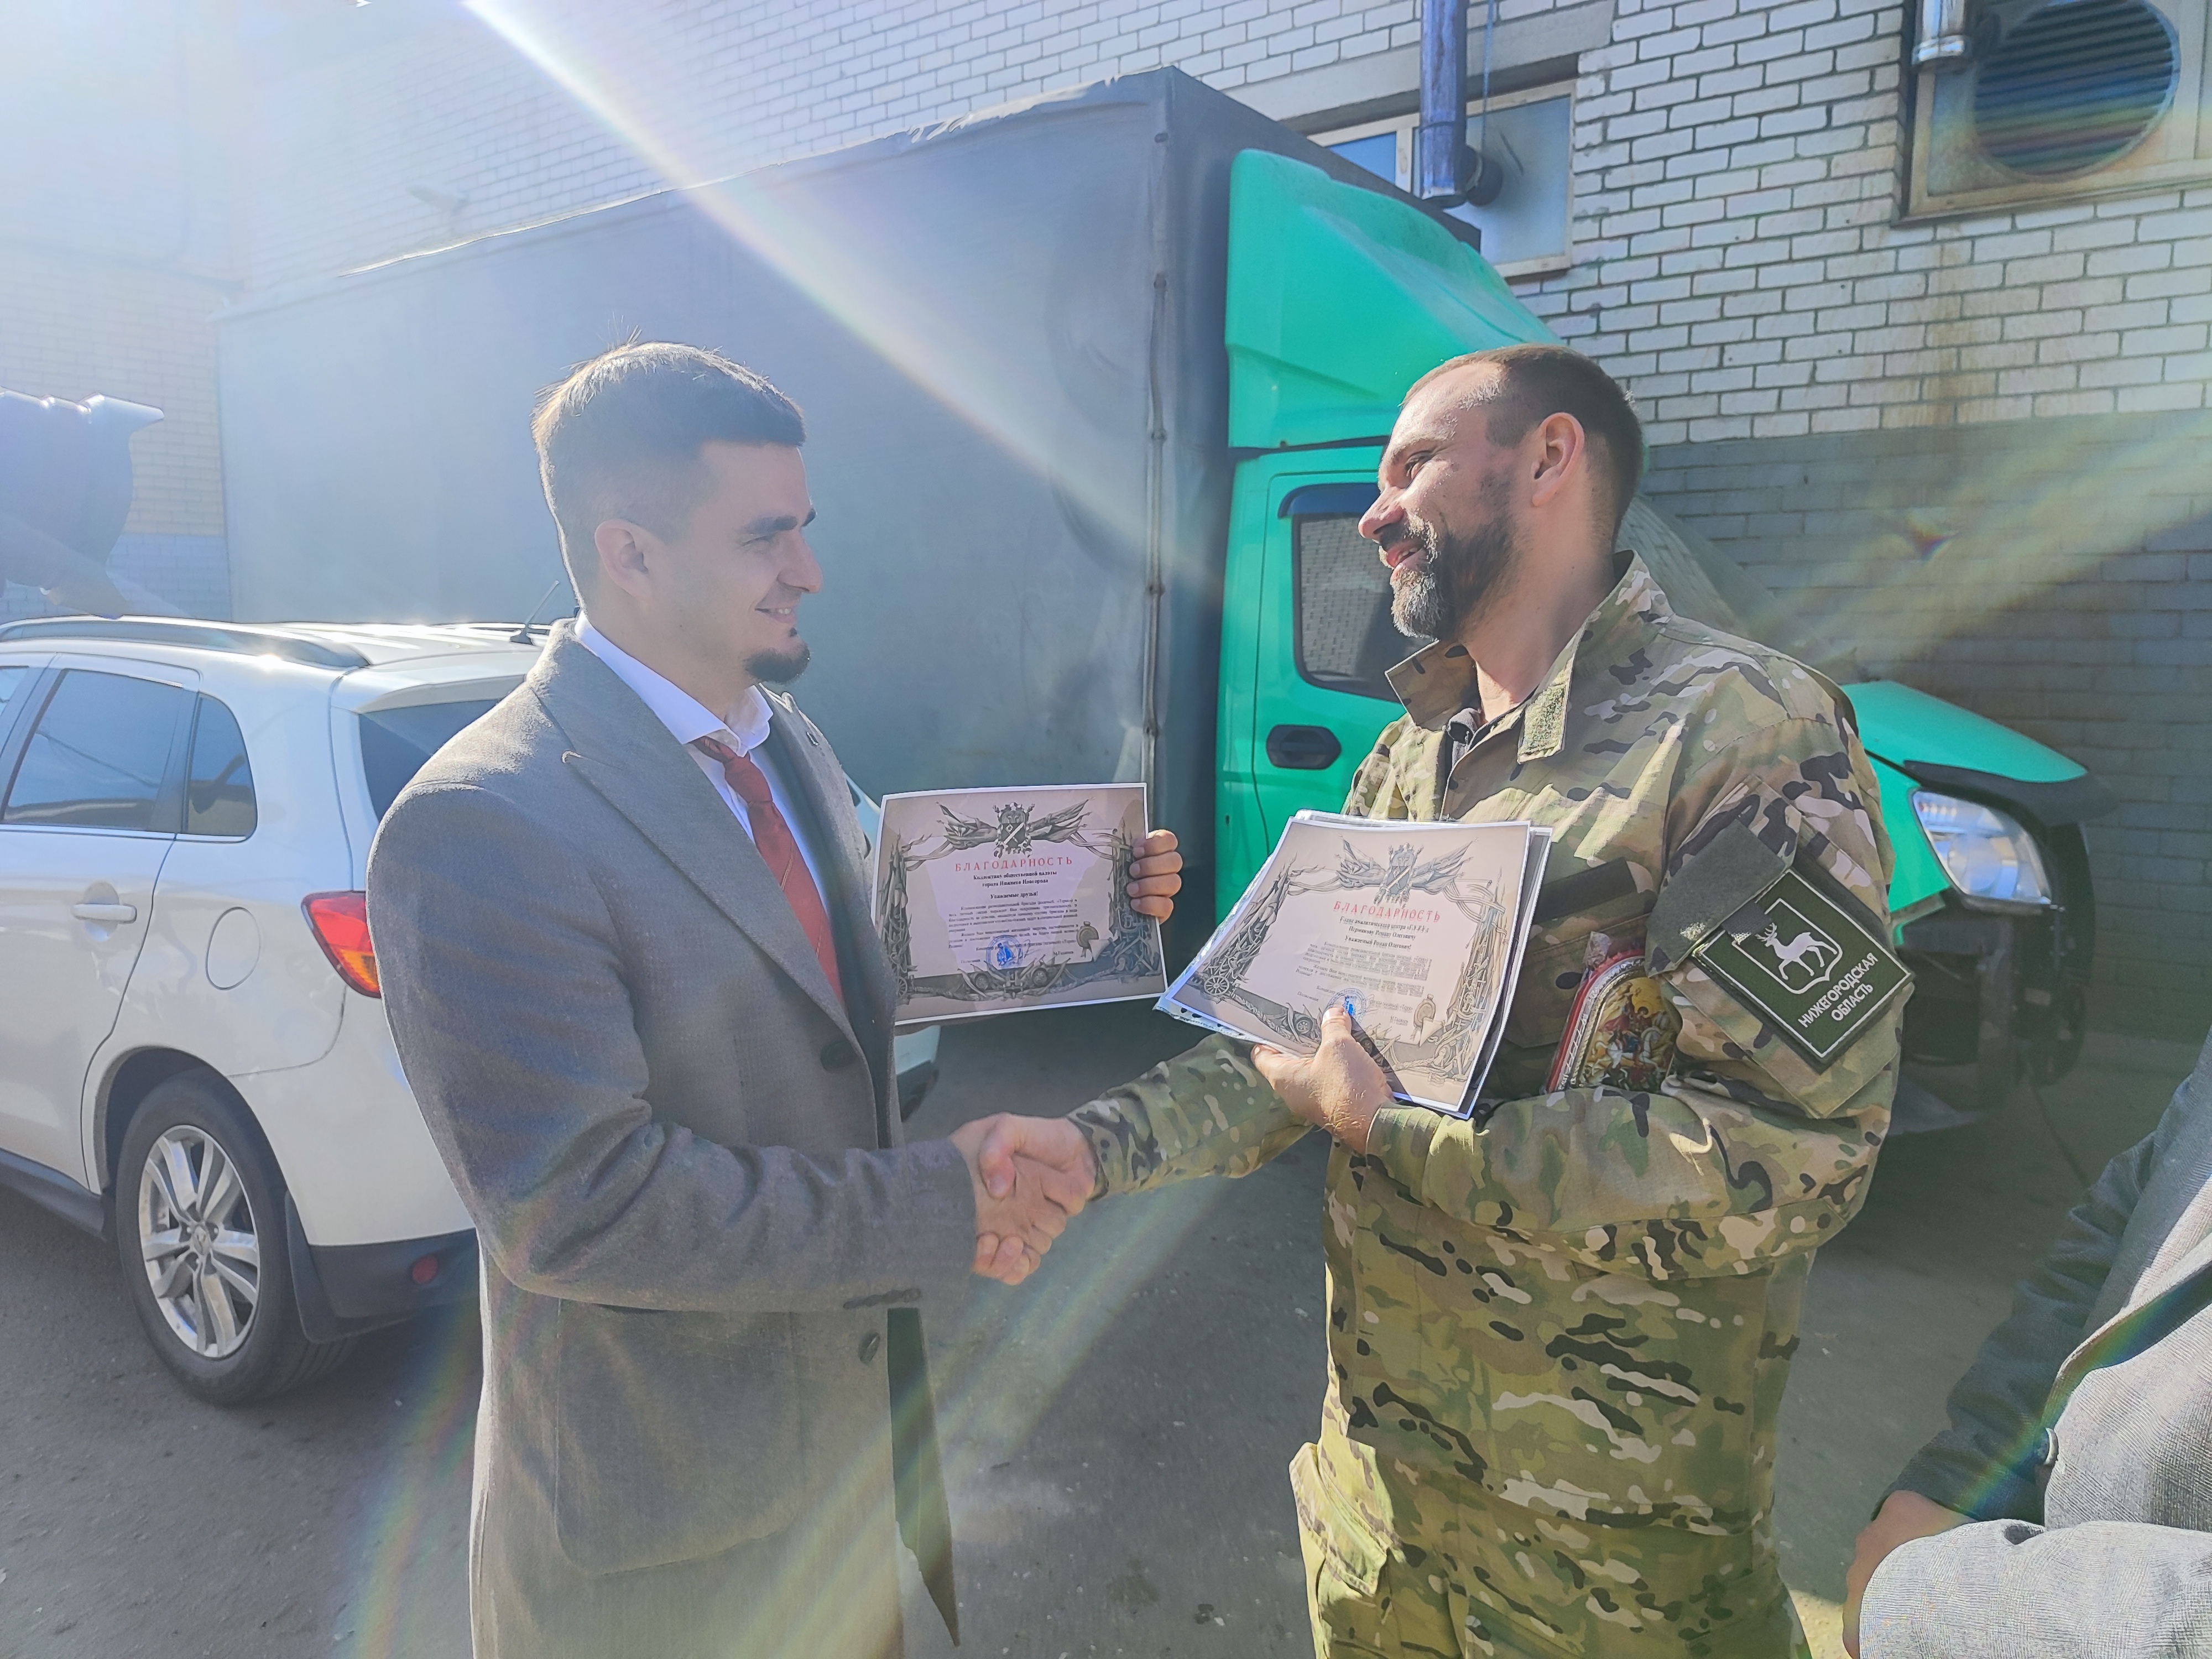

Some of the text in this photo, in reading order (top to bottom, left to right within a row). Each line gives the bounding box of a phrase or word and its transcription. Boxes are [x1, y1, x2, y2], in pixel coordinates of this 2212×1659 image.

[956, 857, 1072, 872] БЛАГОДАРНОСТЬ
[1333, 901, 1440, 921] БЛАГОДАРНОСТЬ
[1798, 952, 1879, 1027] НИЖЕГОРОДСКАЯ
[1831, 983, 1874, 1021] ОБЛАСТЬ
